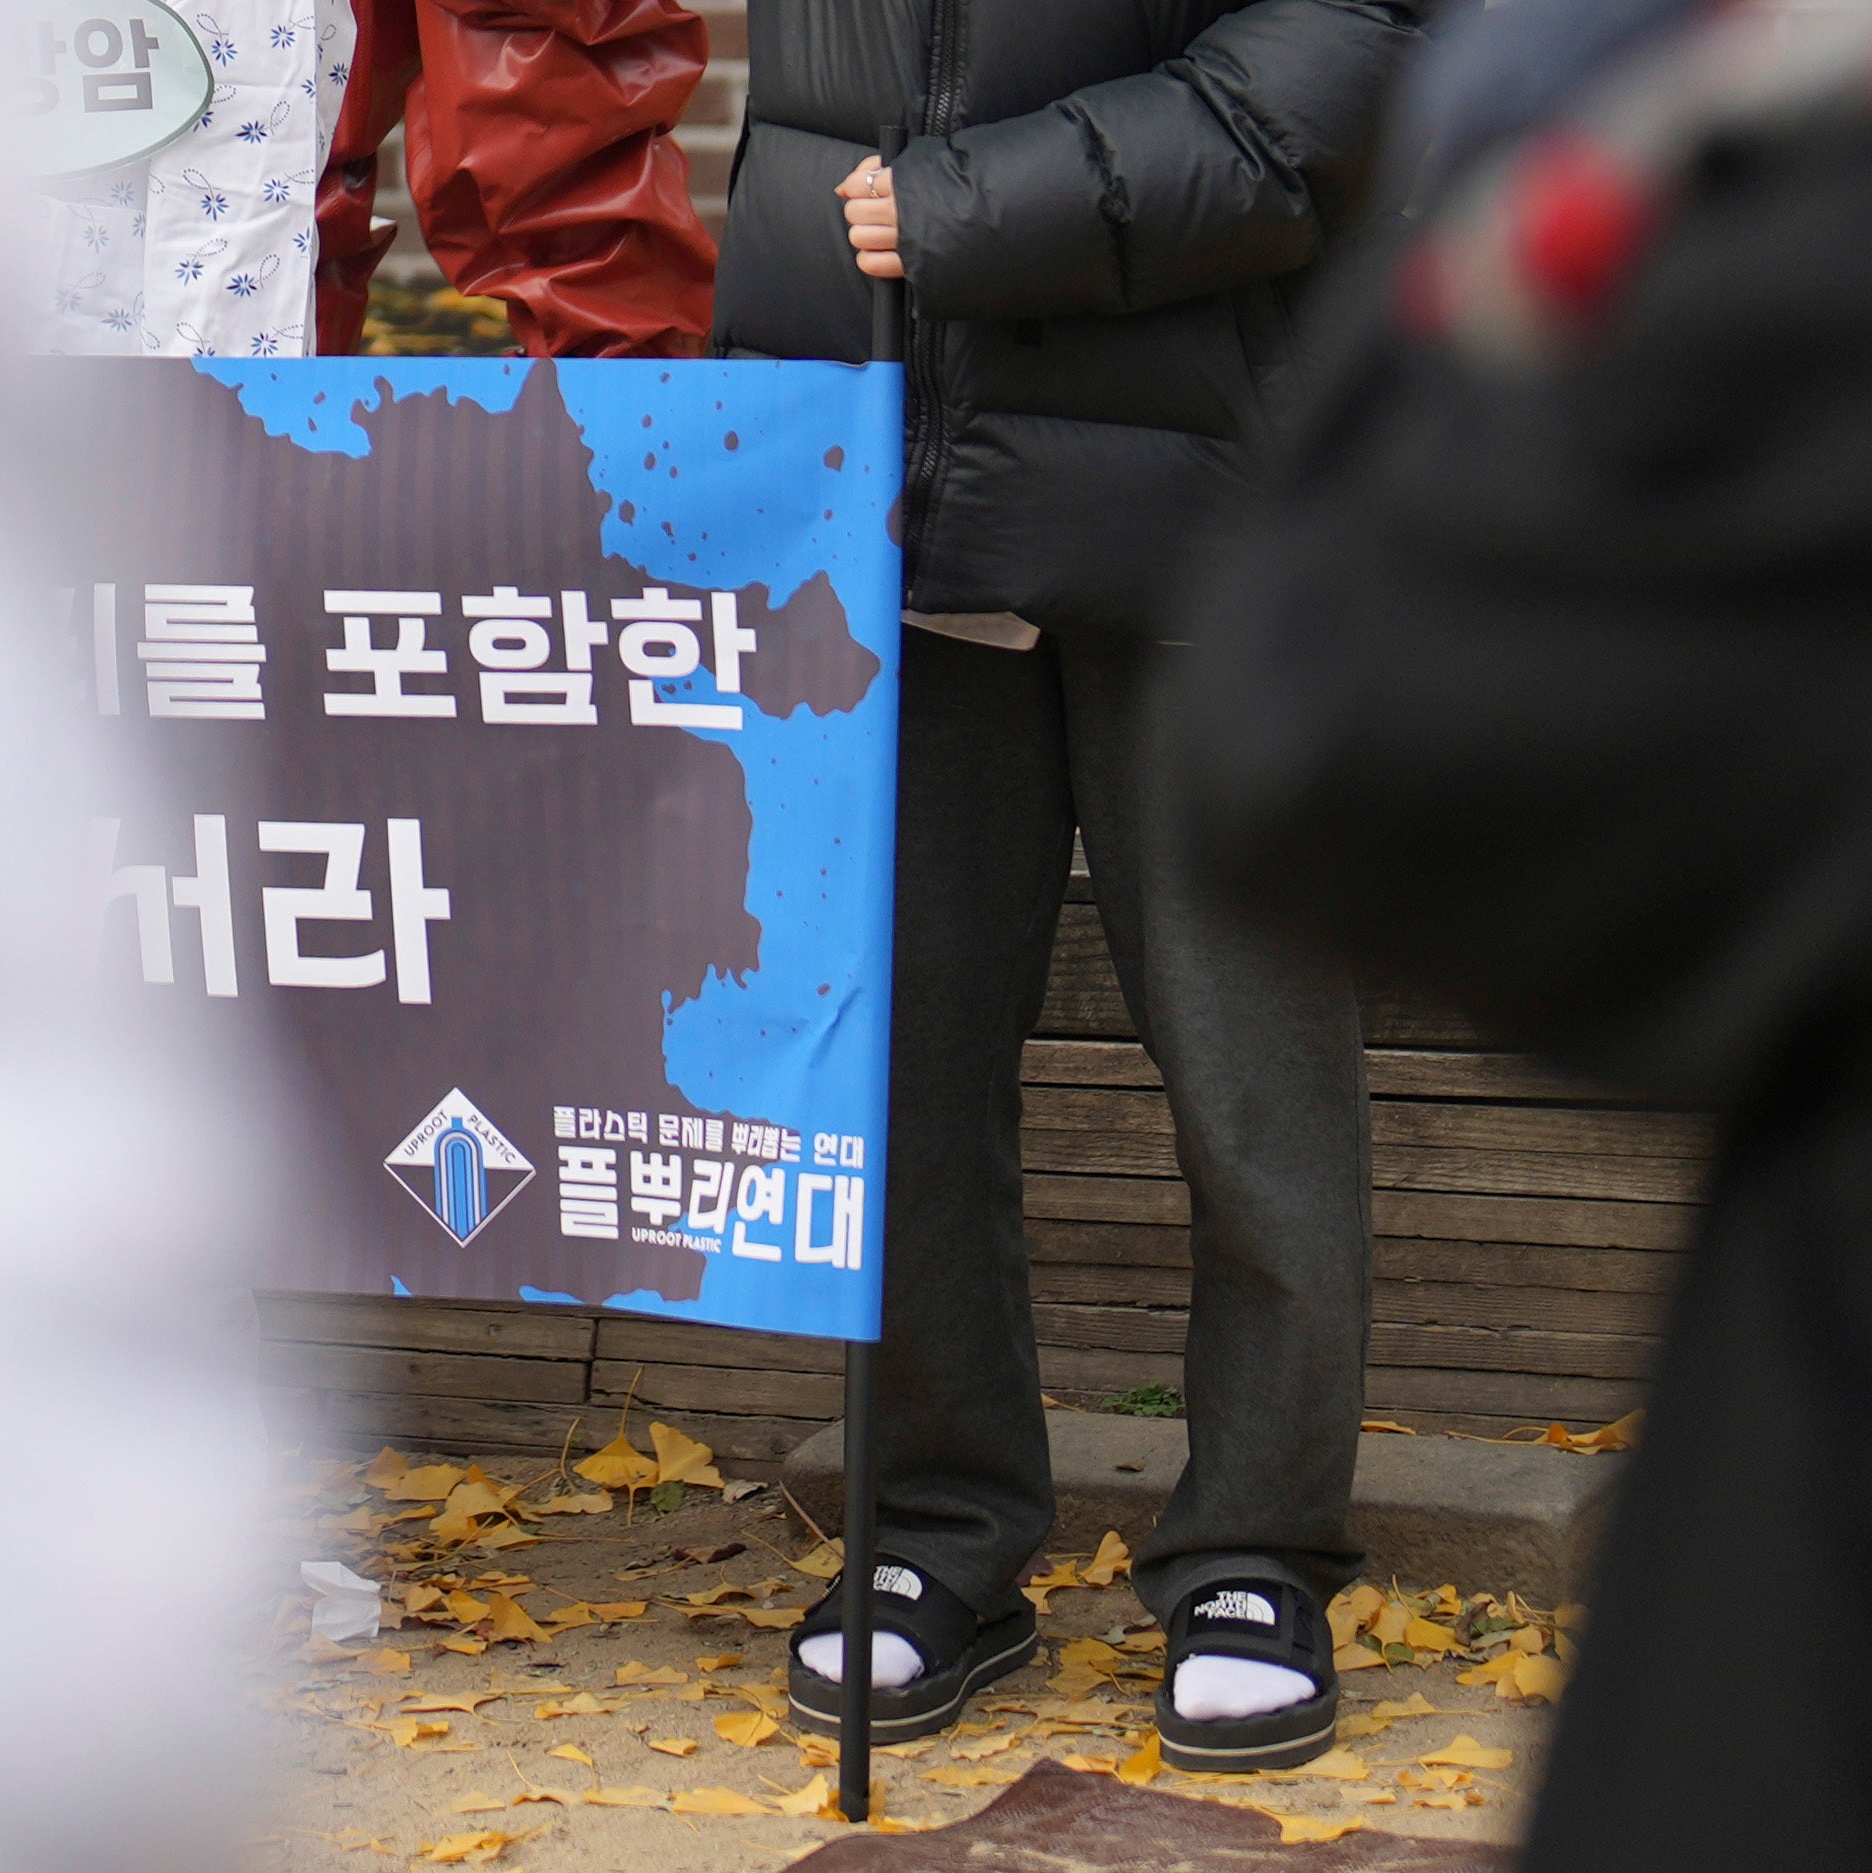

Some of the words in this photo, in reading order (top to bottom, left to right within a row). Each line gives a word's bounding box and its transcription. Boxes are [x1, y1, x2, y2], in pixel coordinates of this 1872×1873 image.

[323, 585, 758, 731] 포함한
[403, 1108, 448, 1157] UPROOT
[467, 1113, 516, 1164] PLASTIC
[553, 1105, 648, 1144] 플라스틱
[658, 1113, 724, 1152] 문제를
[813, 1131, 864, 1169] 연대
[632, 1226, 681, 1247] UPROOT
[682, 1233, 722, 1254] PLASTIC
[1194, 1599, 1246, 1617] NORTH
[1216, 1590, 1246, 1602] THE
[1208, 1608, 1246, 1620] FACE
